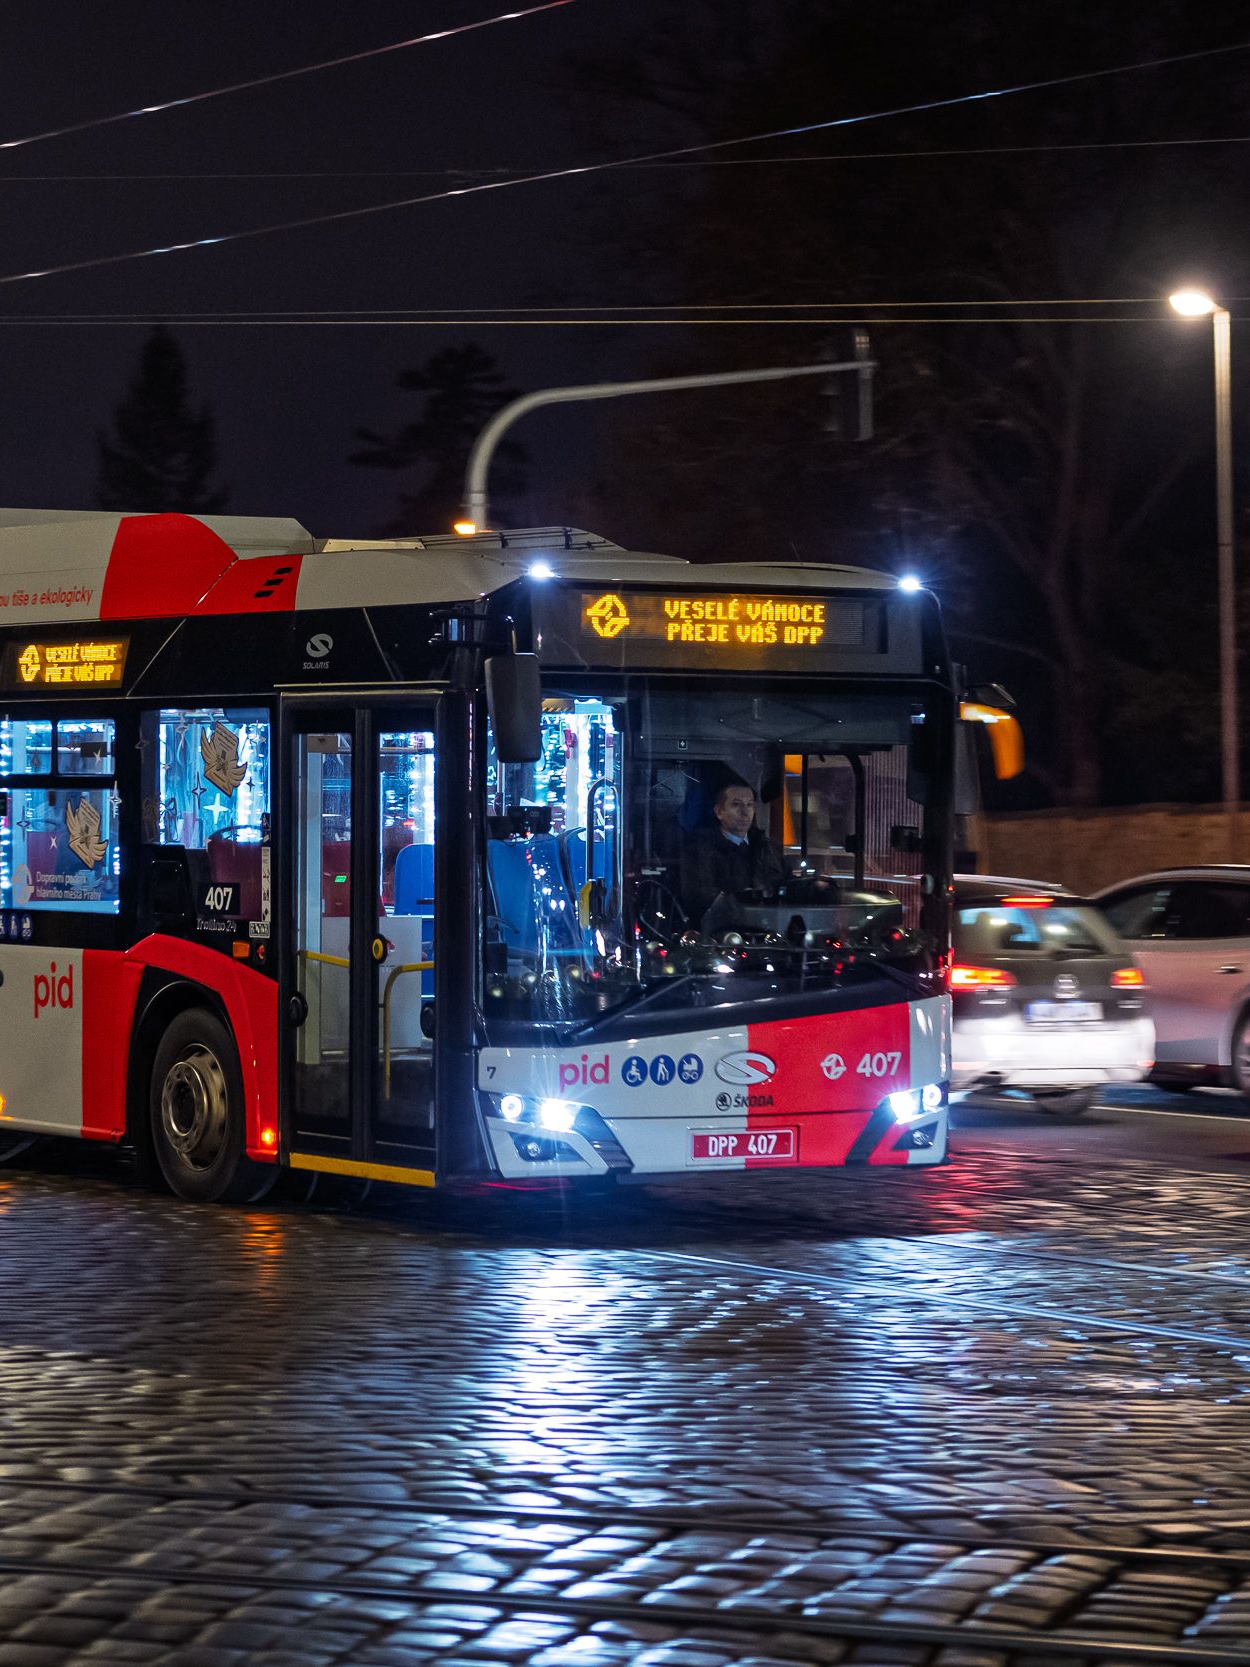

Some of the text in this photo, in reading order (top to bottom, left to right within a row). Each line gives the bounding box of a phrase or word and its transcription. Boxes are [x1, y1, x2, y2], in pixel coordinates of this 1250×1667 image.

[12, 589, 30, 607] tiše
[31, 593, 38, 606] a
[39, 585, 94, 608] ekologicky
[664, 598, 826, 623] VESELÉ VÁNOCE
[666, 619, 825, 645] PŘEJE VÁŠ DPP
[303, 661, 330, 670] SOLARIS
[36, 870, 65, 886] Dopravní
[83, 890, 102, 901] Prahy
[205, 886, 233, 911] 407
[196, 917, 226, 932] Trollino
[226, 919, 237, 933] 24
[34, 961, 74, 1018] pid
[486, 1065, 497, 1080] 7
[558, 1053, 610, 1093] pid
[856, 1051, 902, 1077] 407
[733, 1094, 774, 1108] ŠKODA
[708, 1134, 778, 1156] DPP 407
